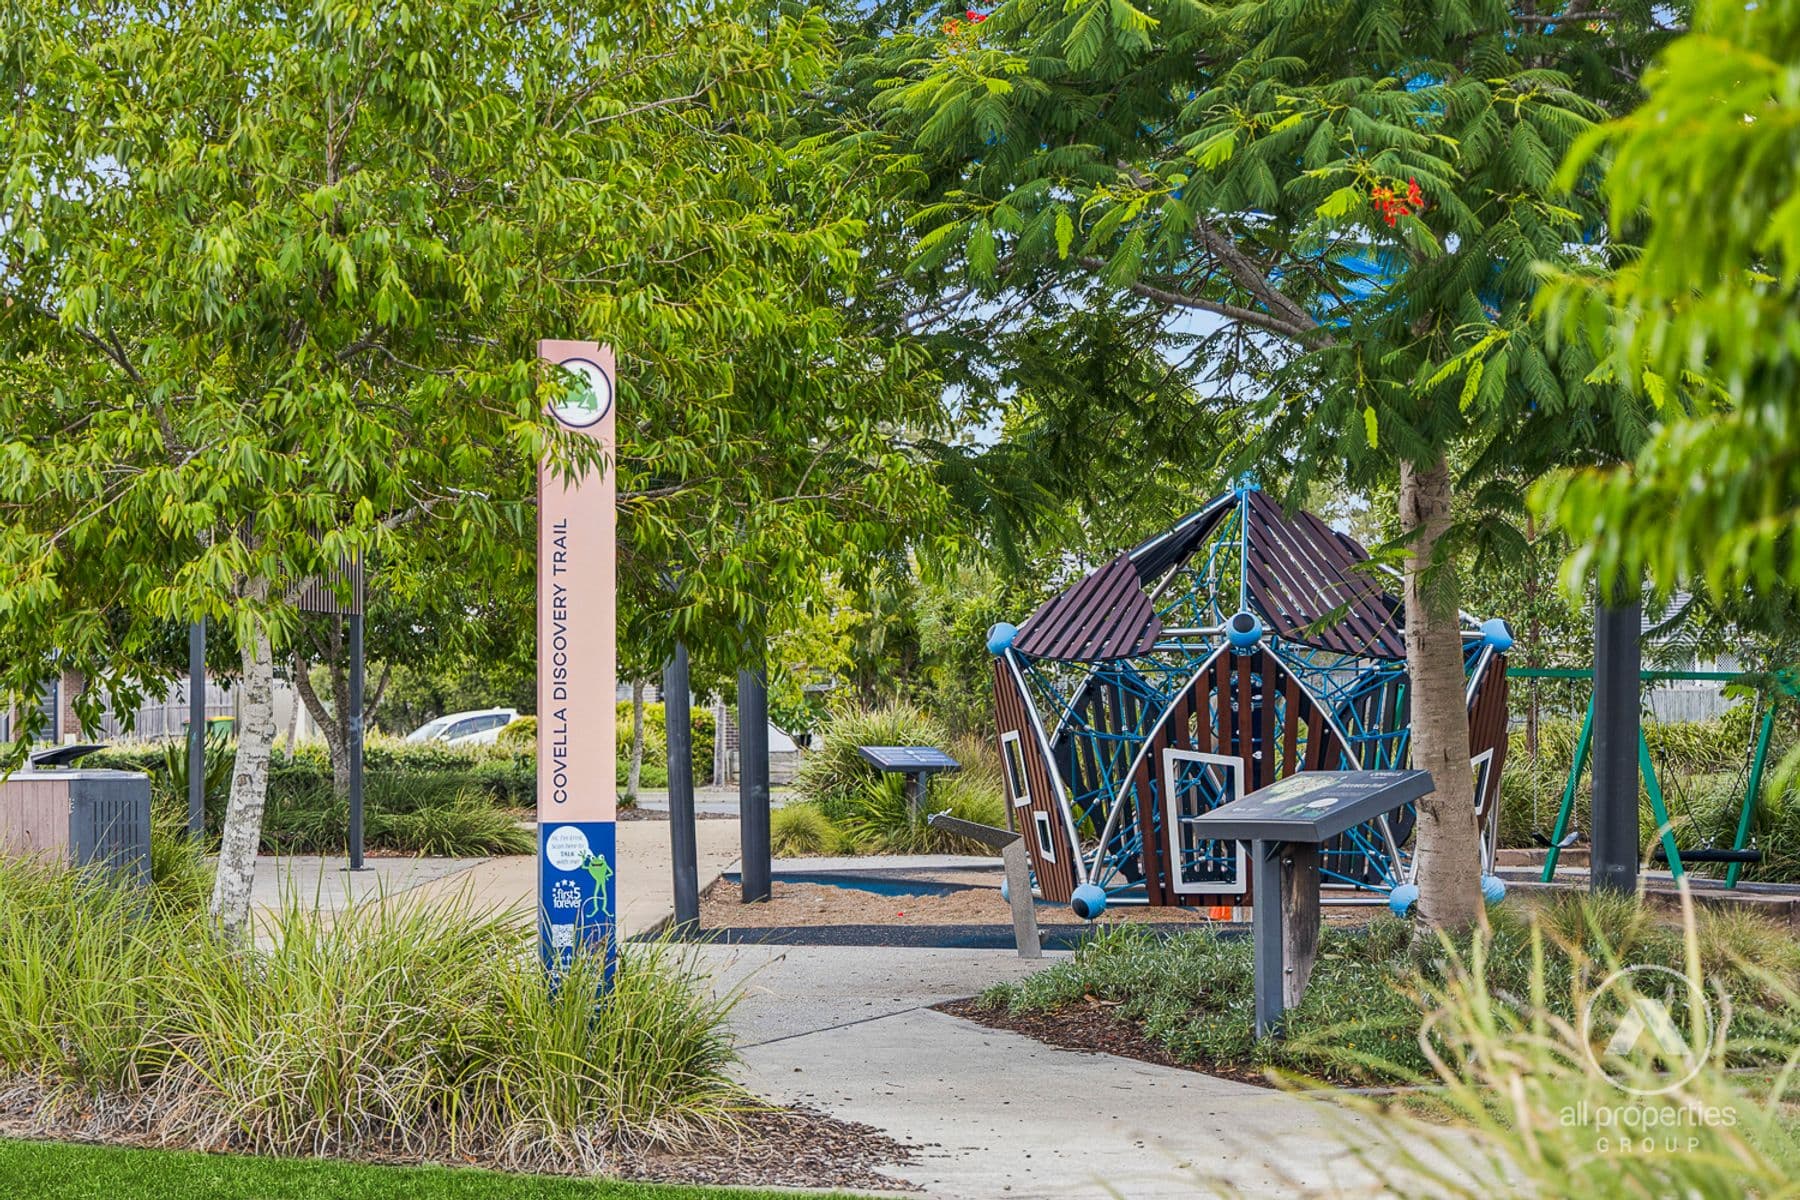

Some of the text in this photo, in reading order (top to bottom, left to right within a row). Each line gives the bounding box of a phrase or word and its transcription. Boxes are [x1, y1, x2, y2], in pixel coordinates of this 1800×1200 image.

[553, 518, 567, 804] COVELLA DISCOVERY TRAIL
[553, 897, 582, 909] forever
